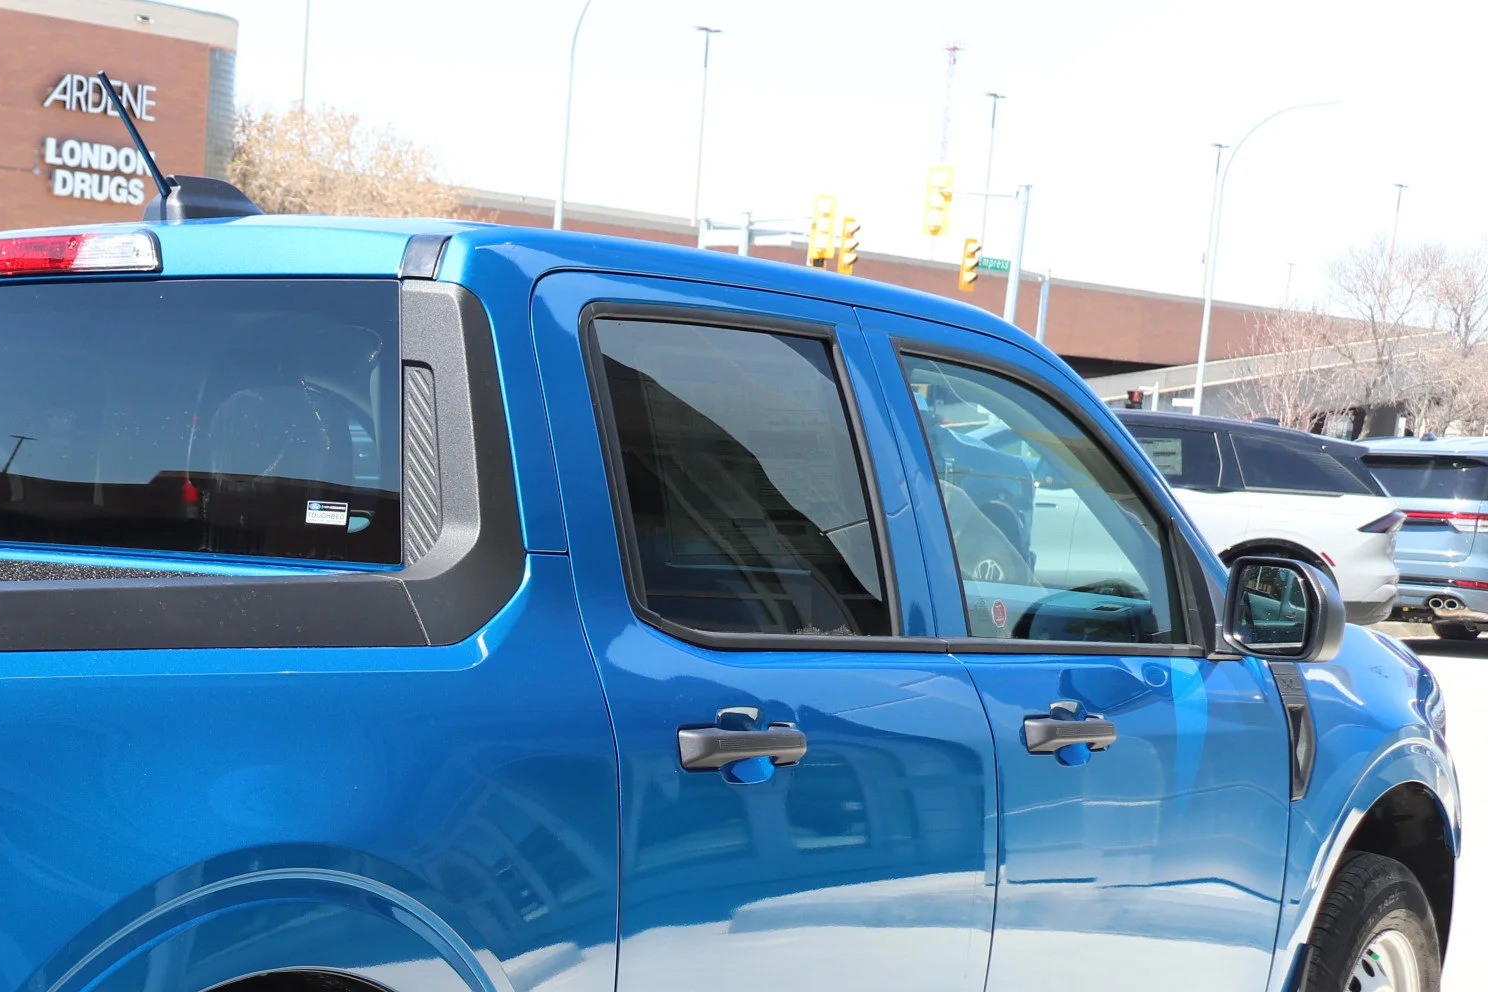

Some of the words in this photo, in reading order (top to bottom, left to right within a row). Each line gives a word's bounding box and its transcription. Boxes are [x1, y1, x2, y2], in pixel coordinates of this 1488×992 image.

[43, 73, 157, 122] ARDENE
[53, 168, 145, 206] DRUGS
[978, 257, 1009, 270] mpress
[308, 512, 345, 520] TOUGHBED
